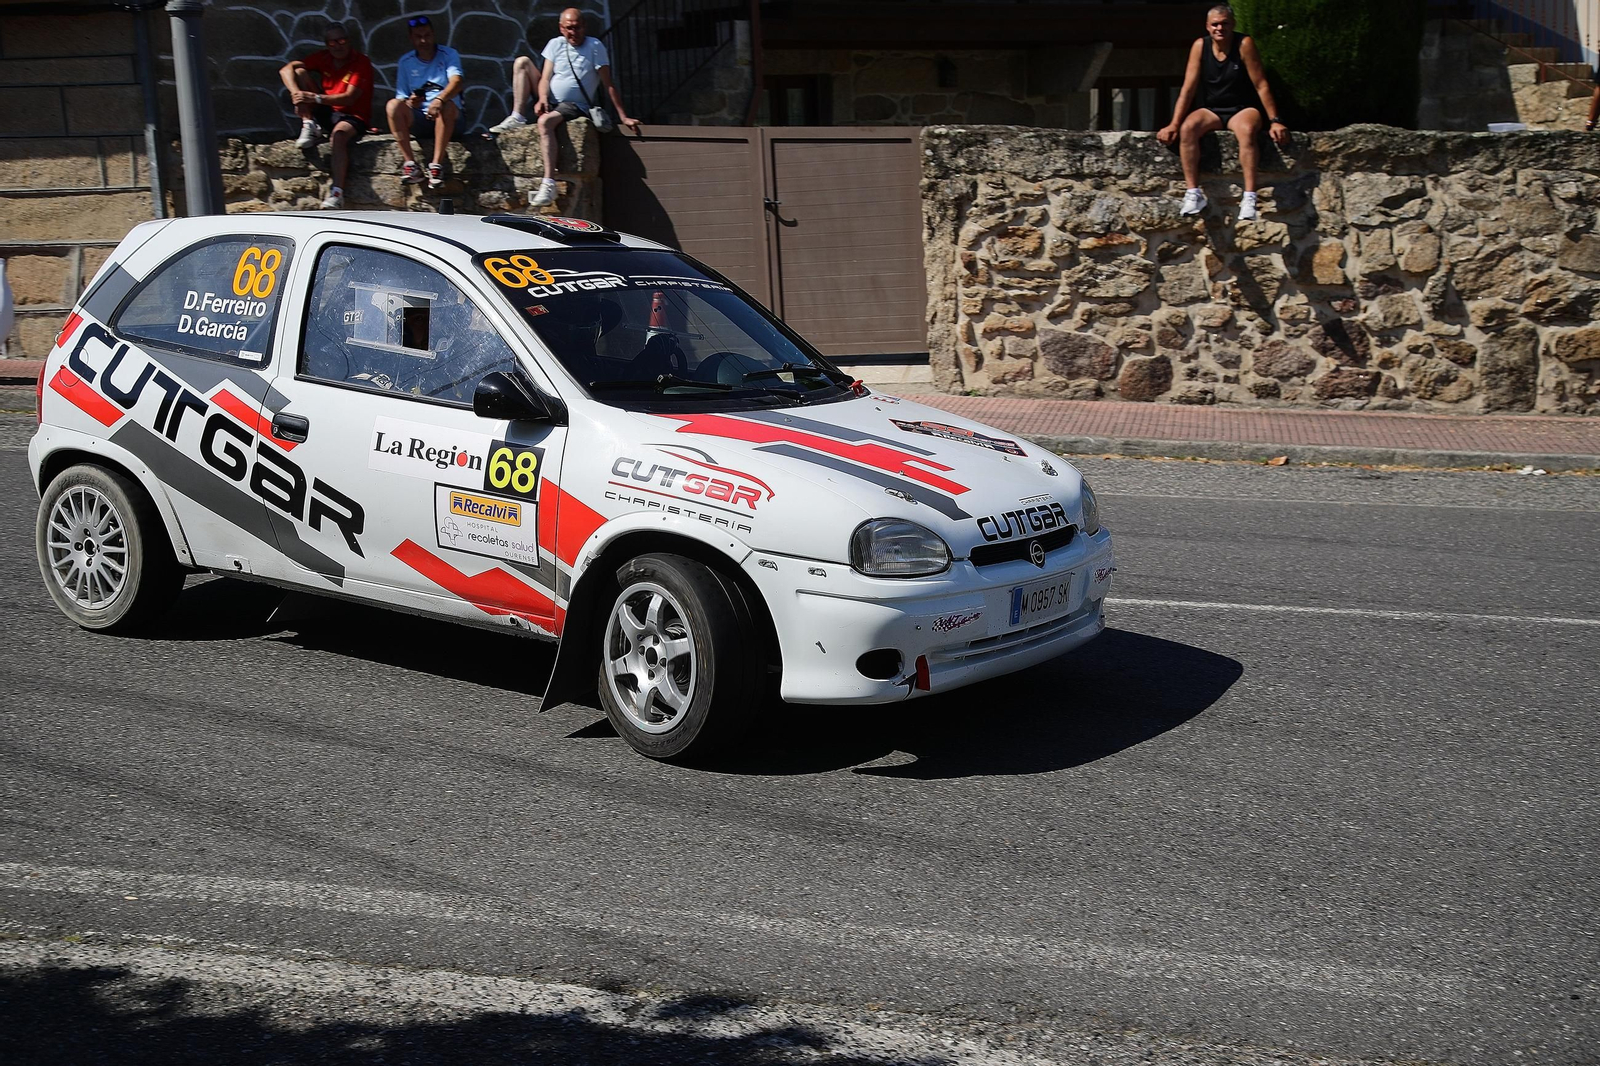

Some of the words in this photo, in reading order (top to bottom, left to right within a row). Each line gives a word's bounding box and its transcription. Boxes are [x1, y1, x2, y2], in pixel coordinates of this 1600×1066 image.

[232, 246, 282, 298] 68
[483, 255, 555, 289] 68
[183, 290, 267, 317] D.Ferreiro
[177, 314, 248, 341] D.García
[68, 322, 366, 559] CUTGAR
[373, 431, 402, 456] La
[406, 437, 483, 471] Región
[488, 447, 538, 493] 68
[463, 498, 508, 520] Recalvi
[604, 491, 752, 534] CHAPISTERÍA
[466, 521, 499, 533] HOSPITAL
[467, 532, 509, 548] recoletas
[511, 540, 534, 553] salud
[504, 551, 535, 563] OURENSE
[1020, 593, 1029, 616] M
[1031, 586, 1056, 613] 0957
[1057, 581, 1070, 605] SK
